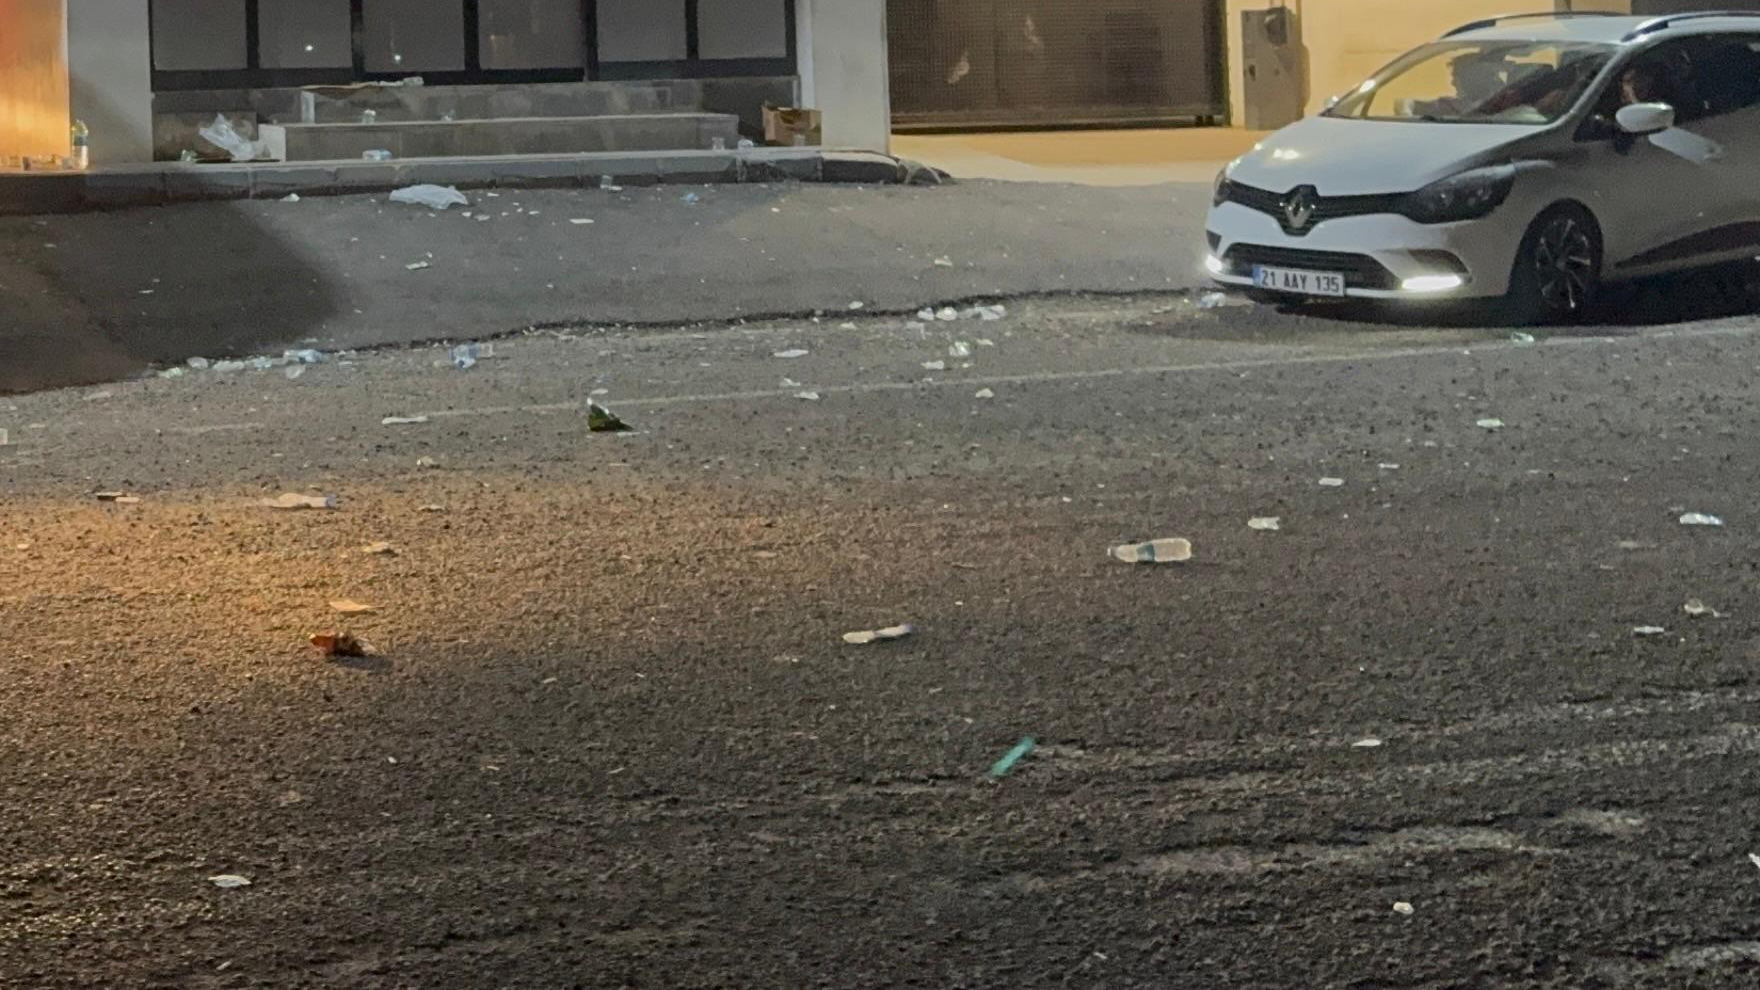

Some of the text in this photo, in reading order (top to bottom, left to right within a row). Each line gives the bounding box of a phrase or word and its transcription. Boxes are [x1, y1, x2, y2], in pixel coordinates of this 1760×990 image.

[1262, 269, 1340, 294] 21 AAY 135
